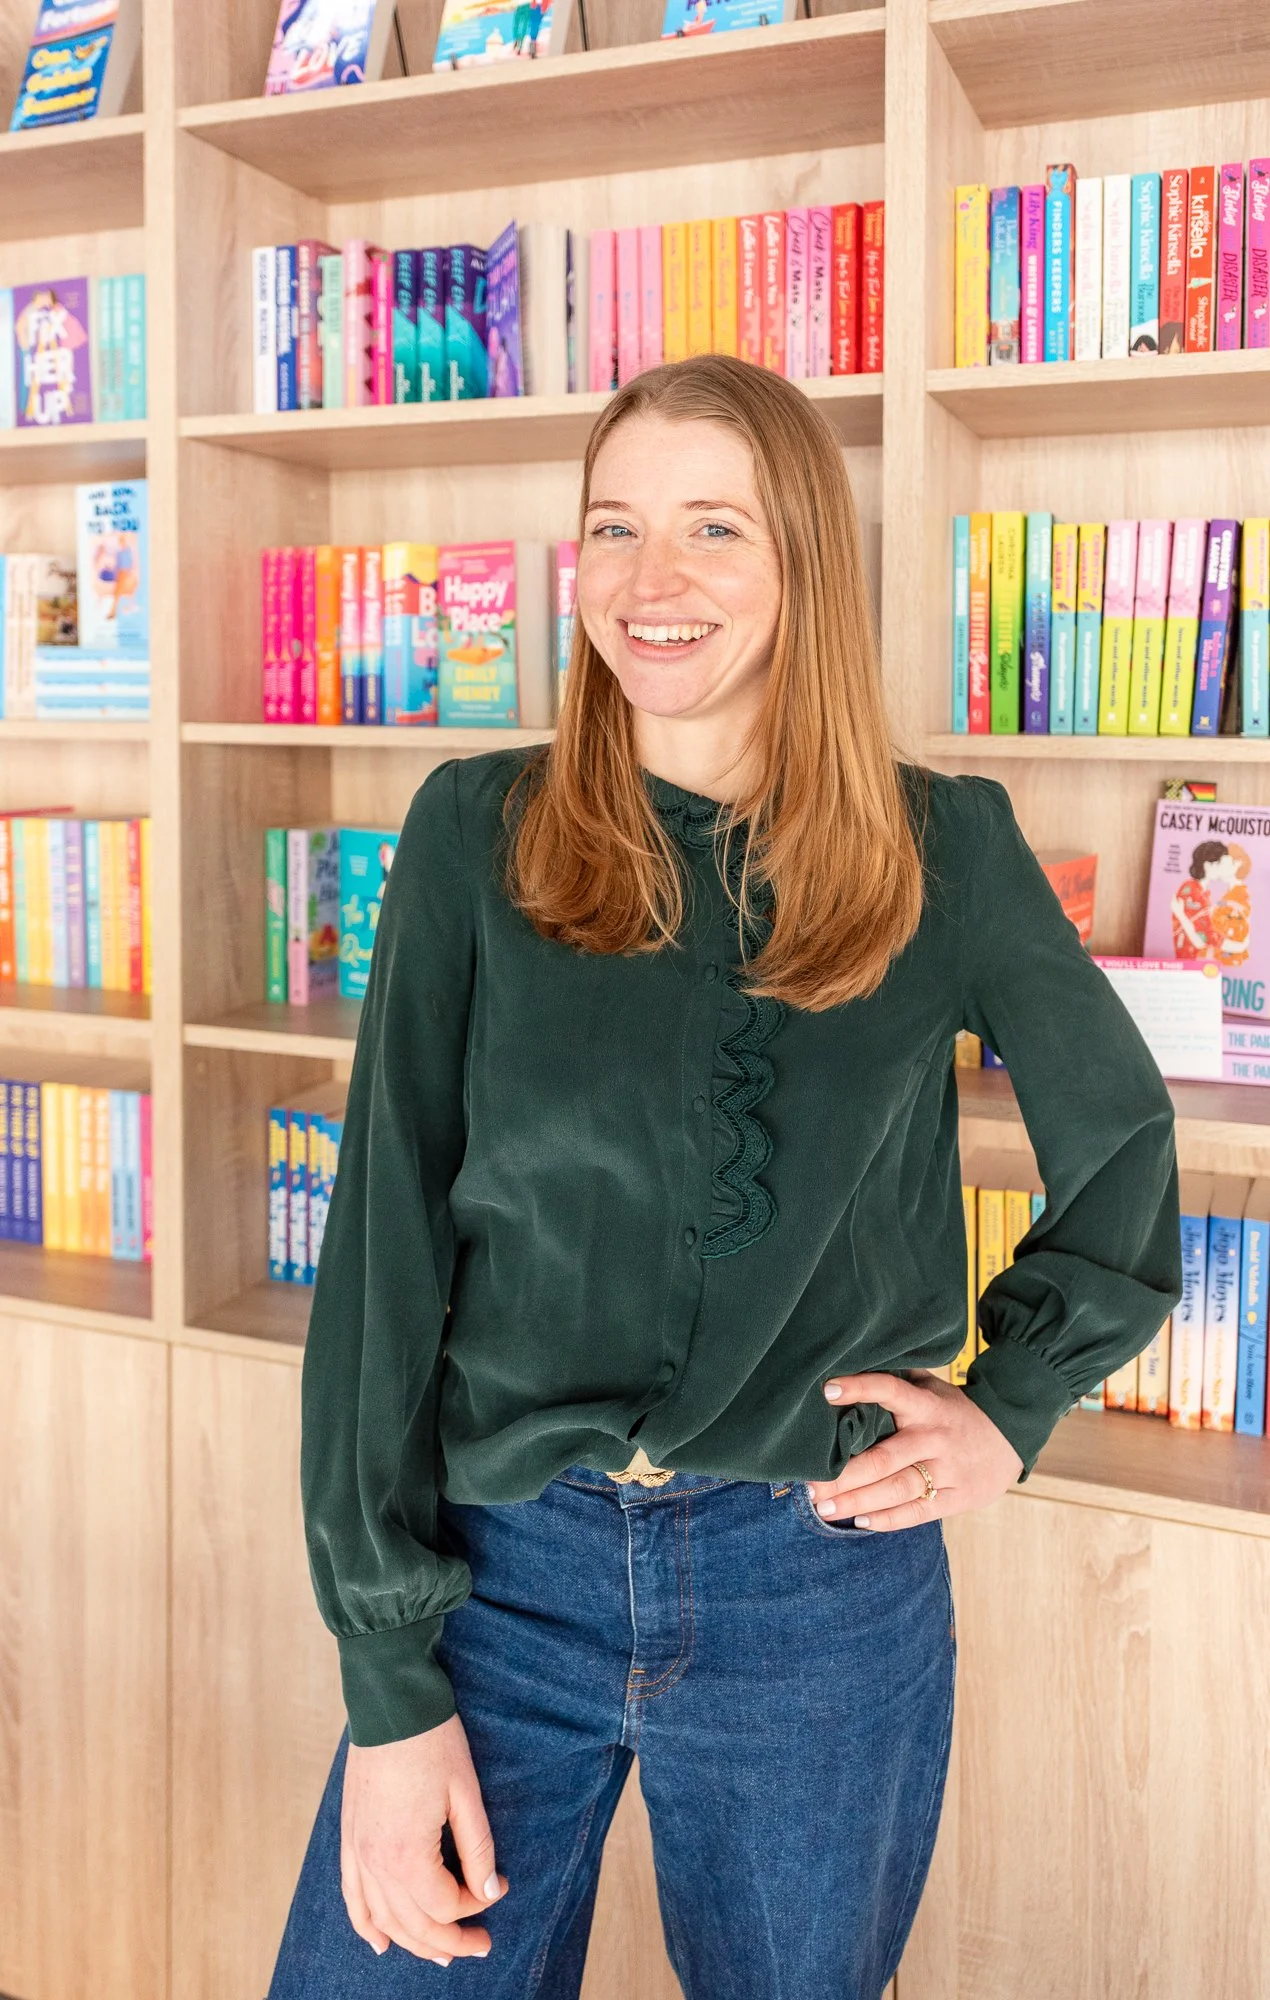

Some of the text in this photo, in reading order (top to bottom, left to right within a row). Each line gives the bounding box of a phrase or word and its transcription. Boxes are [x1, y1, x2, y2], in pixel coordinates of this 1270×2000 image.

[32, 48, 71, 70] One
[26, 66, 92, 94] Golden
[23, 87, 97, 116] Summer
[1026, 191, 1041, 249] Lily King
[1223, 182, 1242, 227] Flirting
[1251, 178, 1270, 222] Flirting
[786, 216, 808, 256] Check
[809, 211, 831, 251] Check
[1051, 201, 1062, 255] FINDERS
[1138, 180, 1154, 280] Sophie Kinsella
[1166, 174, 1181, 275] Sophie Kinsella
[1190, 194, 1209, 258] kinsella
[397, 253, 412, 289] DEEP
[423, 251, 437, 288] DEEP
[451, 248, 465, 285] DEEP
[1026, 254, 1038, 304] WRITERS
[1050, 258, 1062, 313] KEEPERS
[1222, 252, 1239, 302] DISASTER
[1251, 248, 1269, 298] DISASTER
[28, 310, 70, 347] FIX
[1026, 319, 1038, 361] LOVERS
[1195, 295, 1208, 348] Shopaholic
[24, 348, 75, 388] HER
[33, 391, 68, 424] UP
[341, 553, 358, 599] Funny
[363, 551, 381, 598] Funny
[1217, 529, 1233, 592] CHRISTINA
[444, 575, 509, 608] Happy
[448, 605, 501, 633] Place
[452, 686, 501, 701] HENRY
[455, 666, 497, 683] EMILY
[1160, 811, 1270, 838] CASEY McQUISTO
[1137, 960, 1160, 969] LOVE
[1221, 977, 1265, 1012] RING
[1228, 1032, 1247, 1047] THE
[1232, 1062, 1251, 1077] THE
[1213, 1227, 1236, 1265] Jojo
[1182, 1227, 1202, 1322] Jojo Moyes
[1212, 1268, 1236, 1323] Moyes
